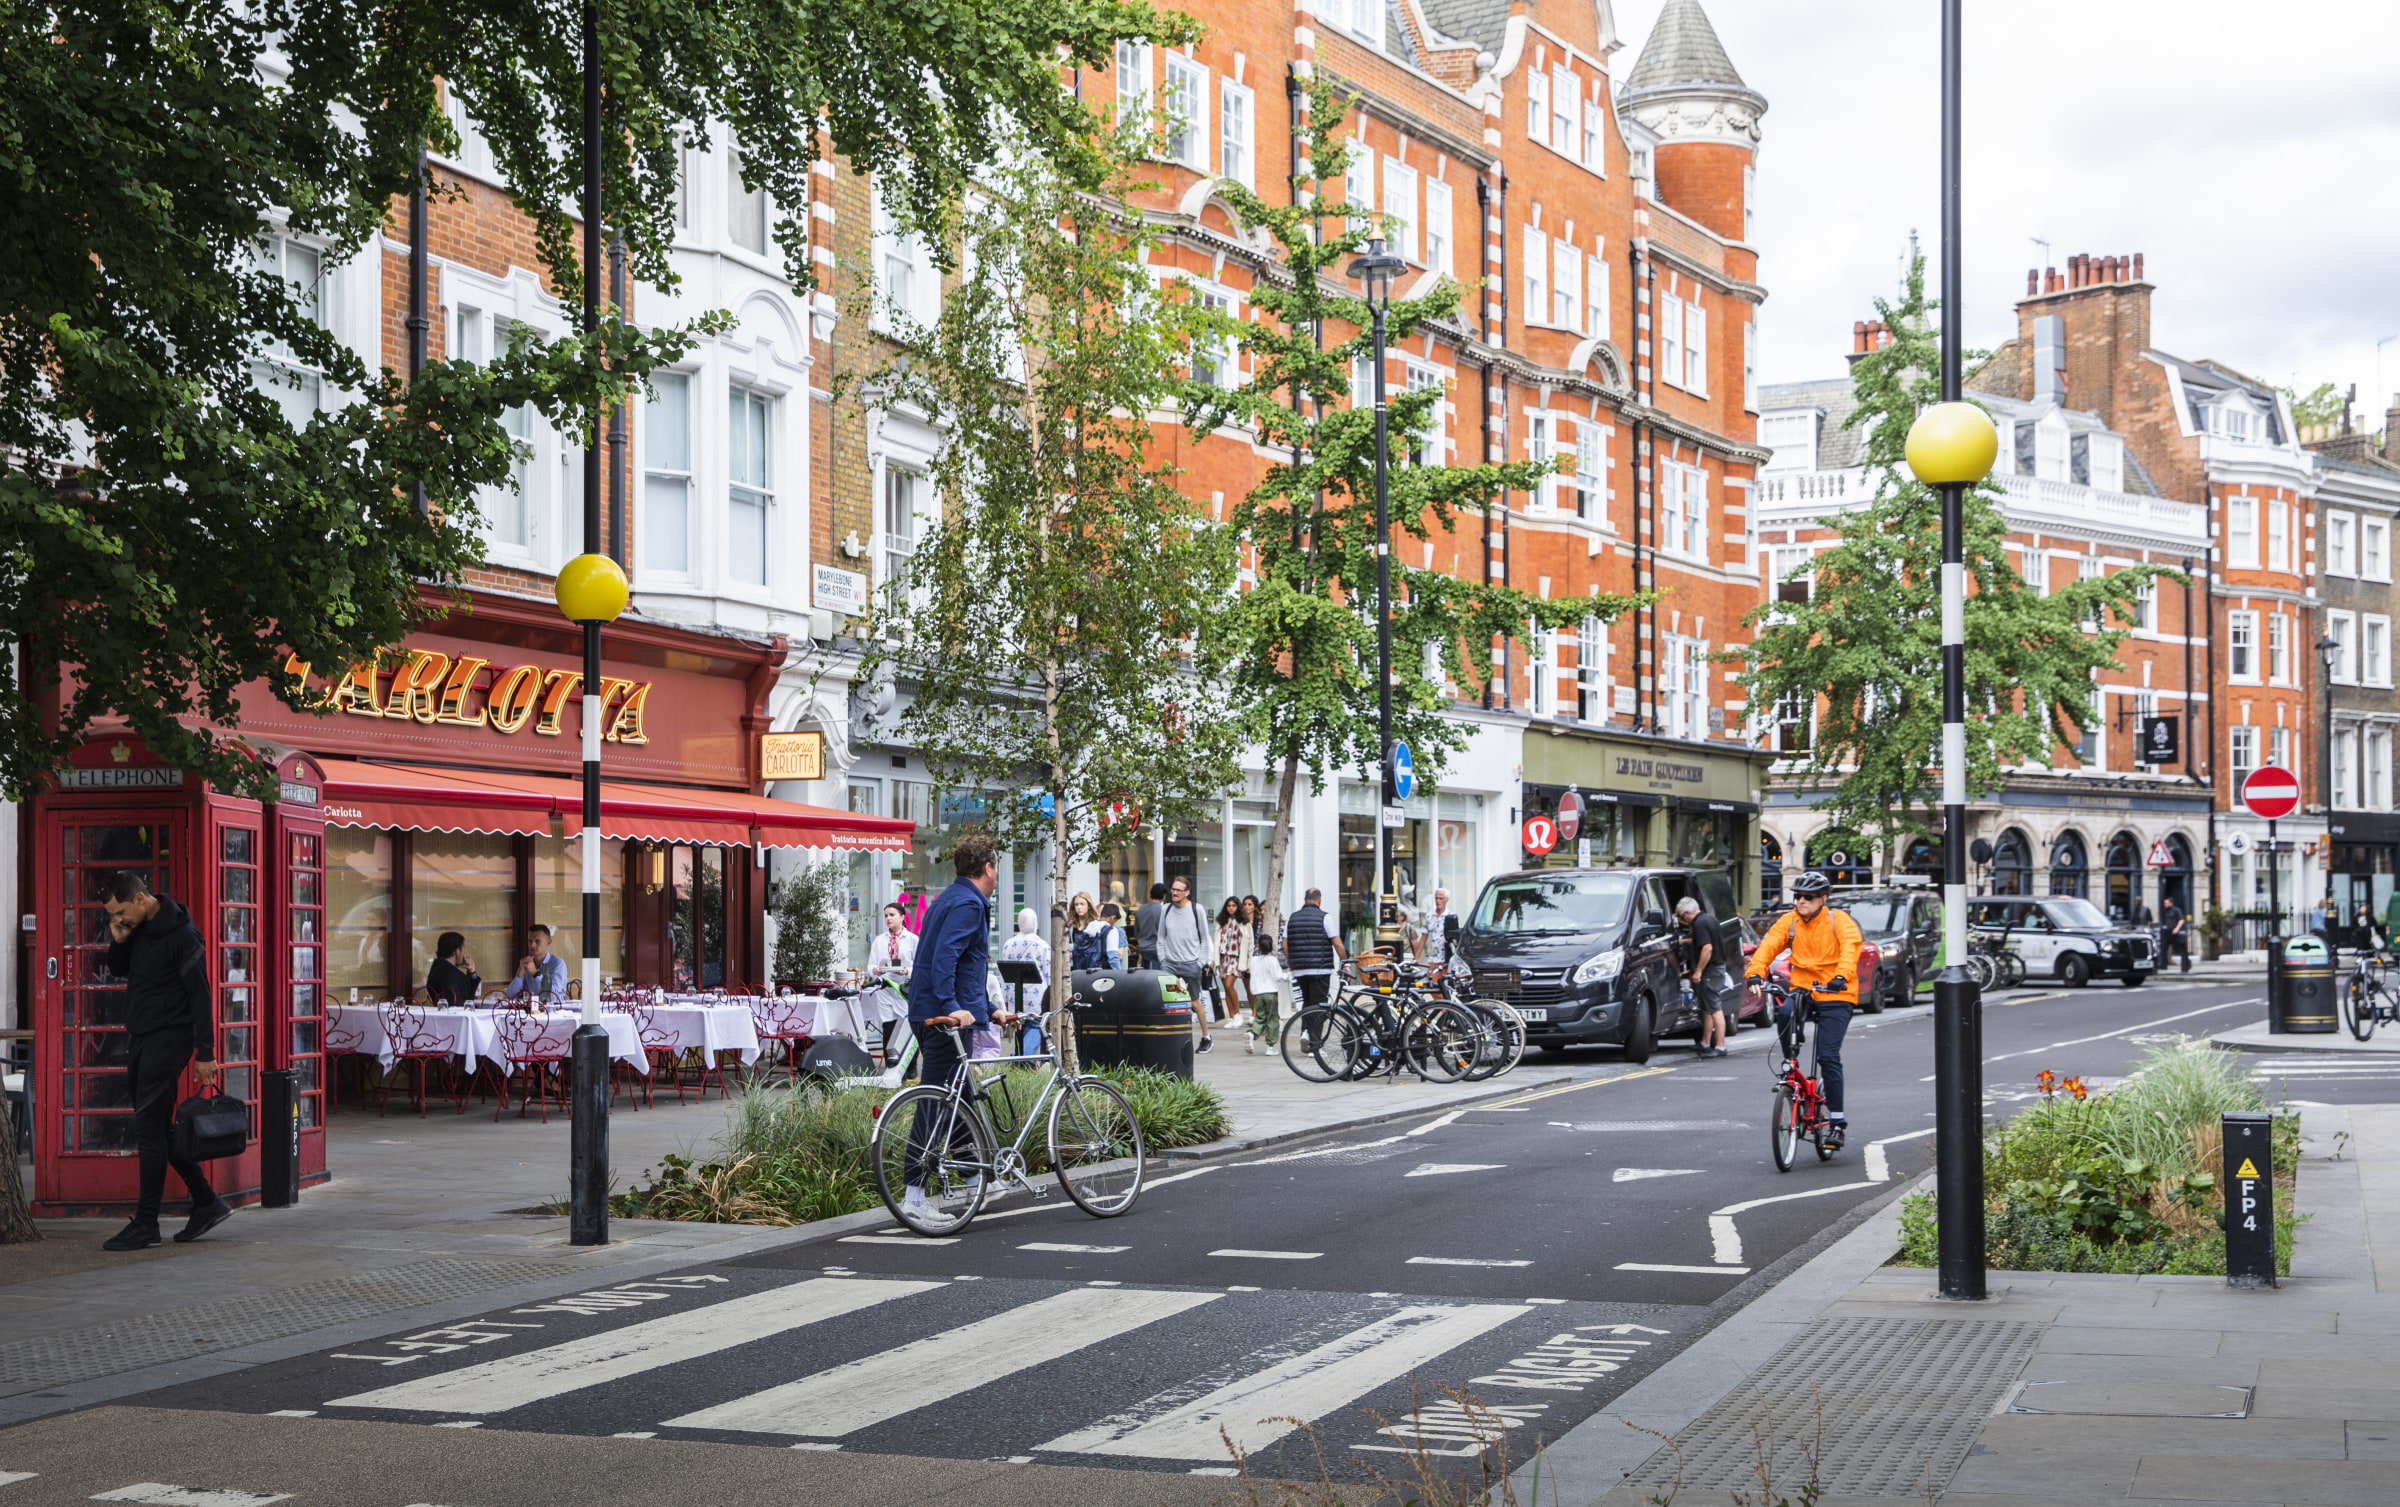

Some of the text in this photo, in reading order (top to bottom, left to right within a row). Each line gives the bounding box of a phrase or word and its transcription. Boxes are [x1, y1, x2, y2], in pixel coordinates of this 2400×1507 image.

[818, 569, 852, 587] MARYLEBONE
[818, 582, 861, 601] HIGH STREET W1
[766, 738, 815, 754] Trattoria
[766, 754, 815, 775] CARLOTTA
[1616, 757, 1629, 774] LE
[1631, 759, 1653, 777] PAIN
[65, 768, 179, 786] TELEPHONE
[281, 784, 316, 803] TELEPHONE
[324, 806, 362, 818] Carlotta
[831, 834, 857, 844] Trattoria
[884, 836, 905, 846] Italiana
[1525, 1010, 1543, 1019] TWY
[329, 1281, 707, 1366] LOOK LEFT
[1348, 1333, 1652, 1457] LOOK RIGHT
